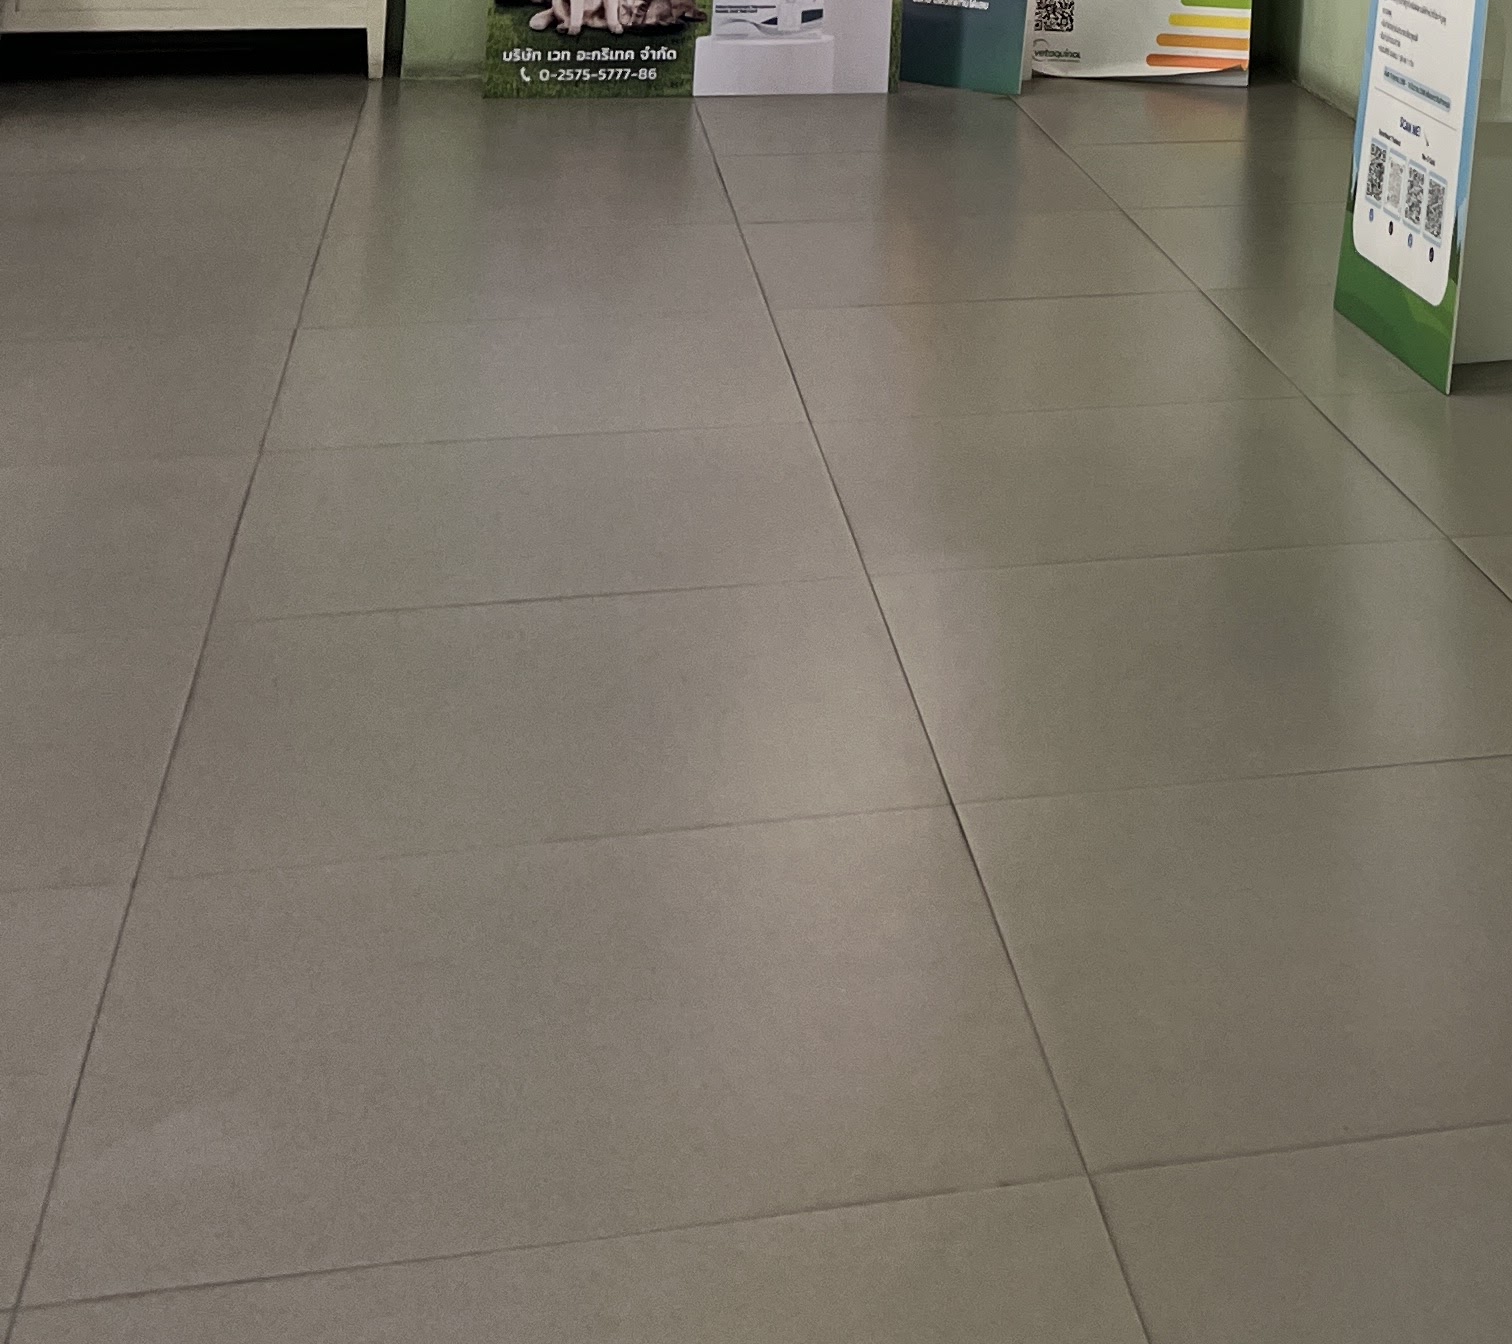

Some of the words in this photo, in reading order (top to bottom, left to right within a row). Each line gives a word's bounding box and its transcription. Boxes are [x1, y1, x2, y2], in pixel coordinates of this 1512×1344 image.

[503, 47, 542, 62] บริษัท
[547, 49, 571, 61] เวท
[641, 46, 677, 62] จำกัด
[539, 68, 657, 81] 0-2575-5777-86
